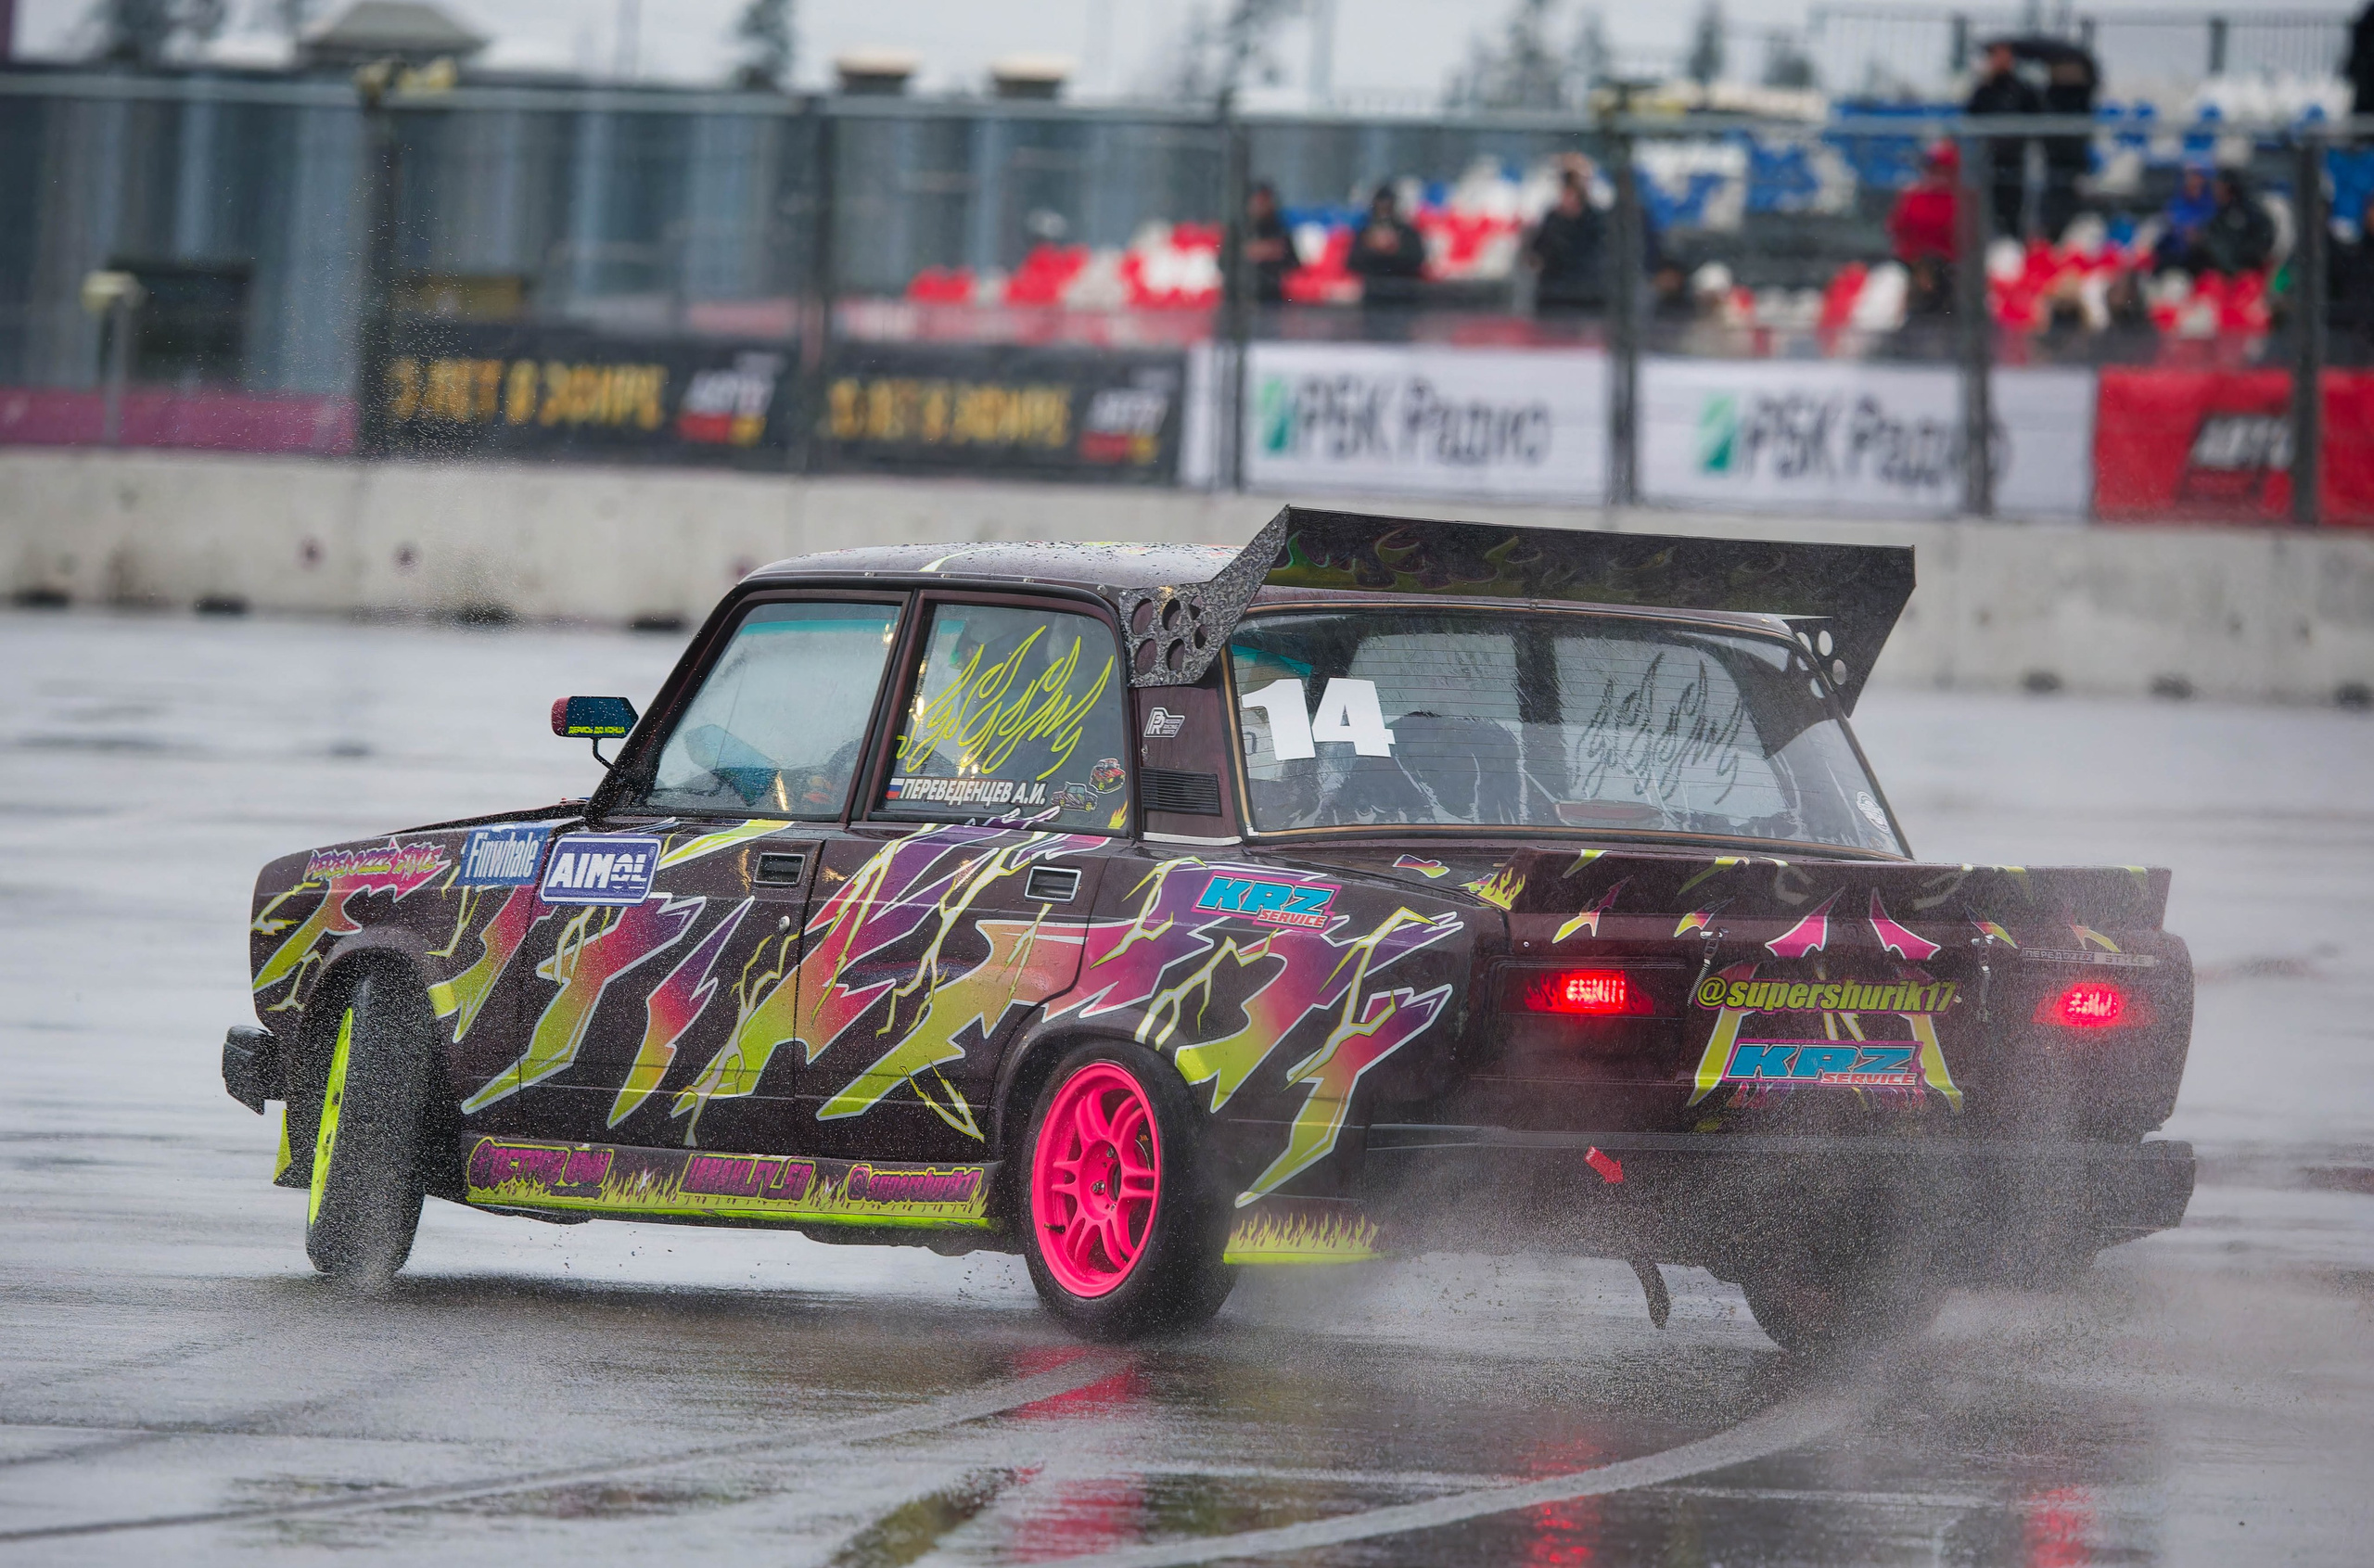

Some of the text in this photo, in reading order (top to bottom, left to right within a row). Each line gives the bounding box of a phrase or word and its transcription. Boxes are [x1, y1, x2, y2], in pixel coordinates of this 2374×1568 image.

[1241, 678, 1396, 760] 14
[900, 778, 1047, 809] ПЕРЕВЕДЕНЦЕВ А.И.
[465, 831, 541, 879] Finwhale
[547, 852, 648, 889] AIMOL
[1257, 909, 1328, 929] SERVICE
[1696, 975, 1956, 1012] @supershurik17
[1821, 1072, 1916, 1086] SERVICE
